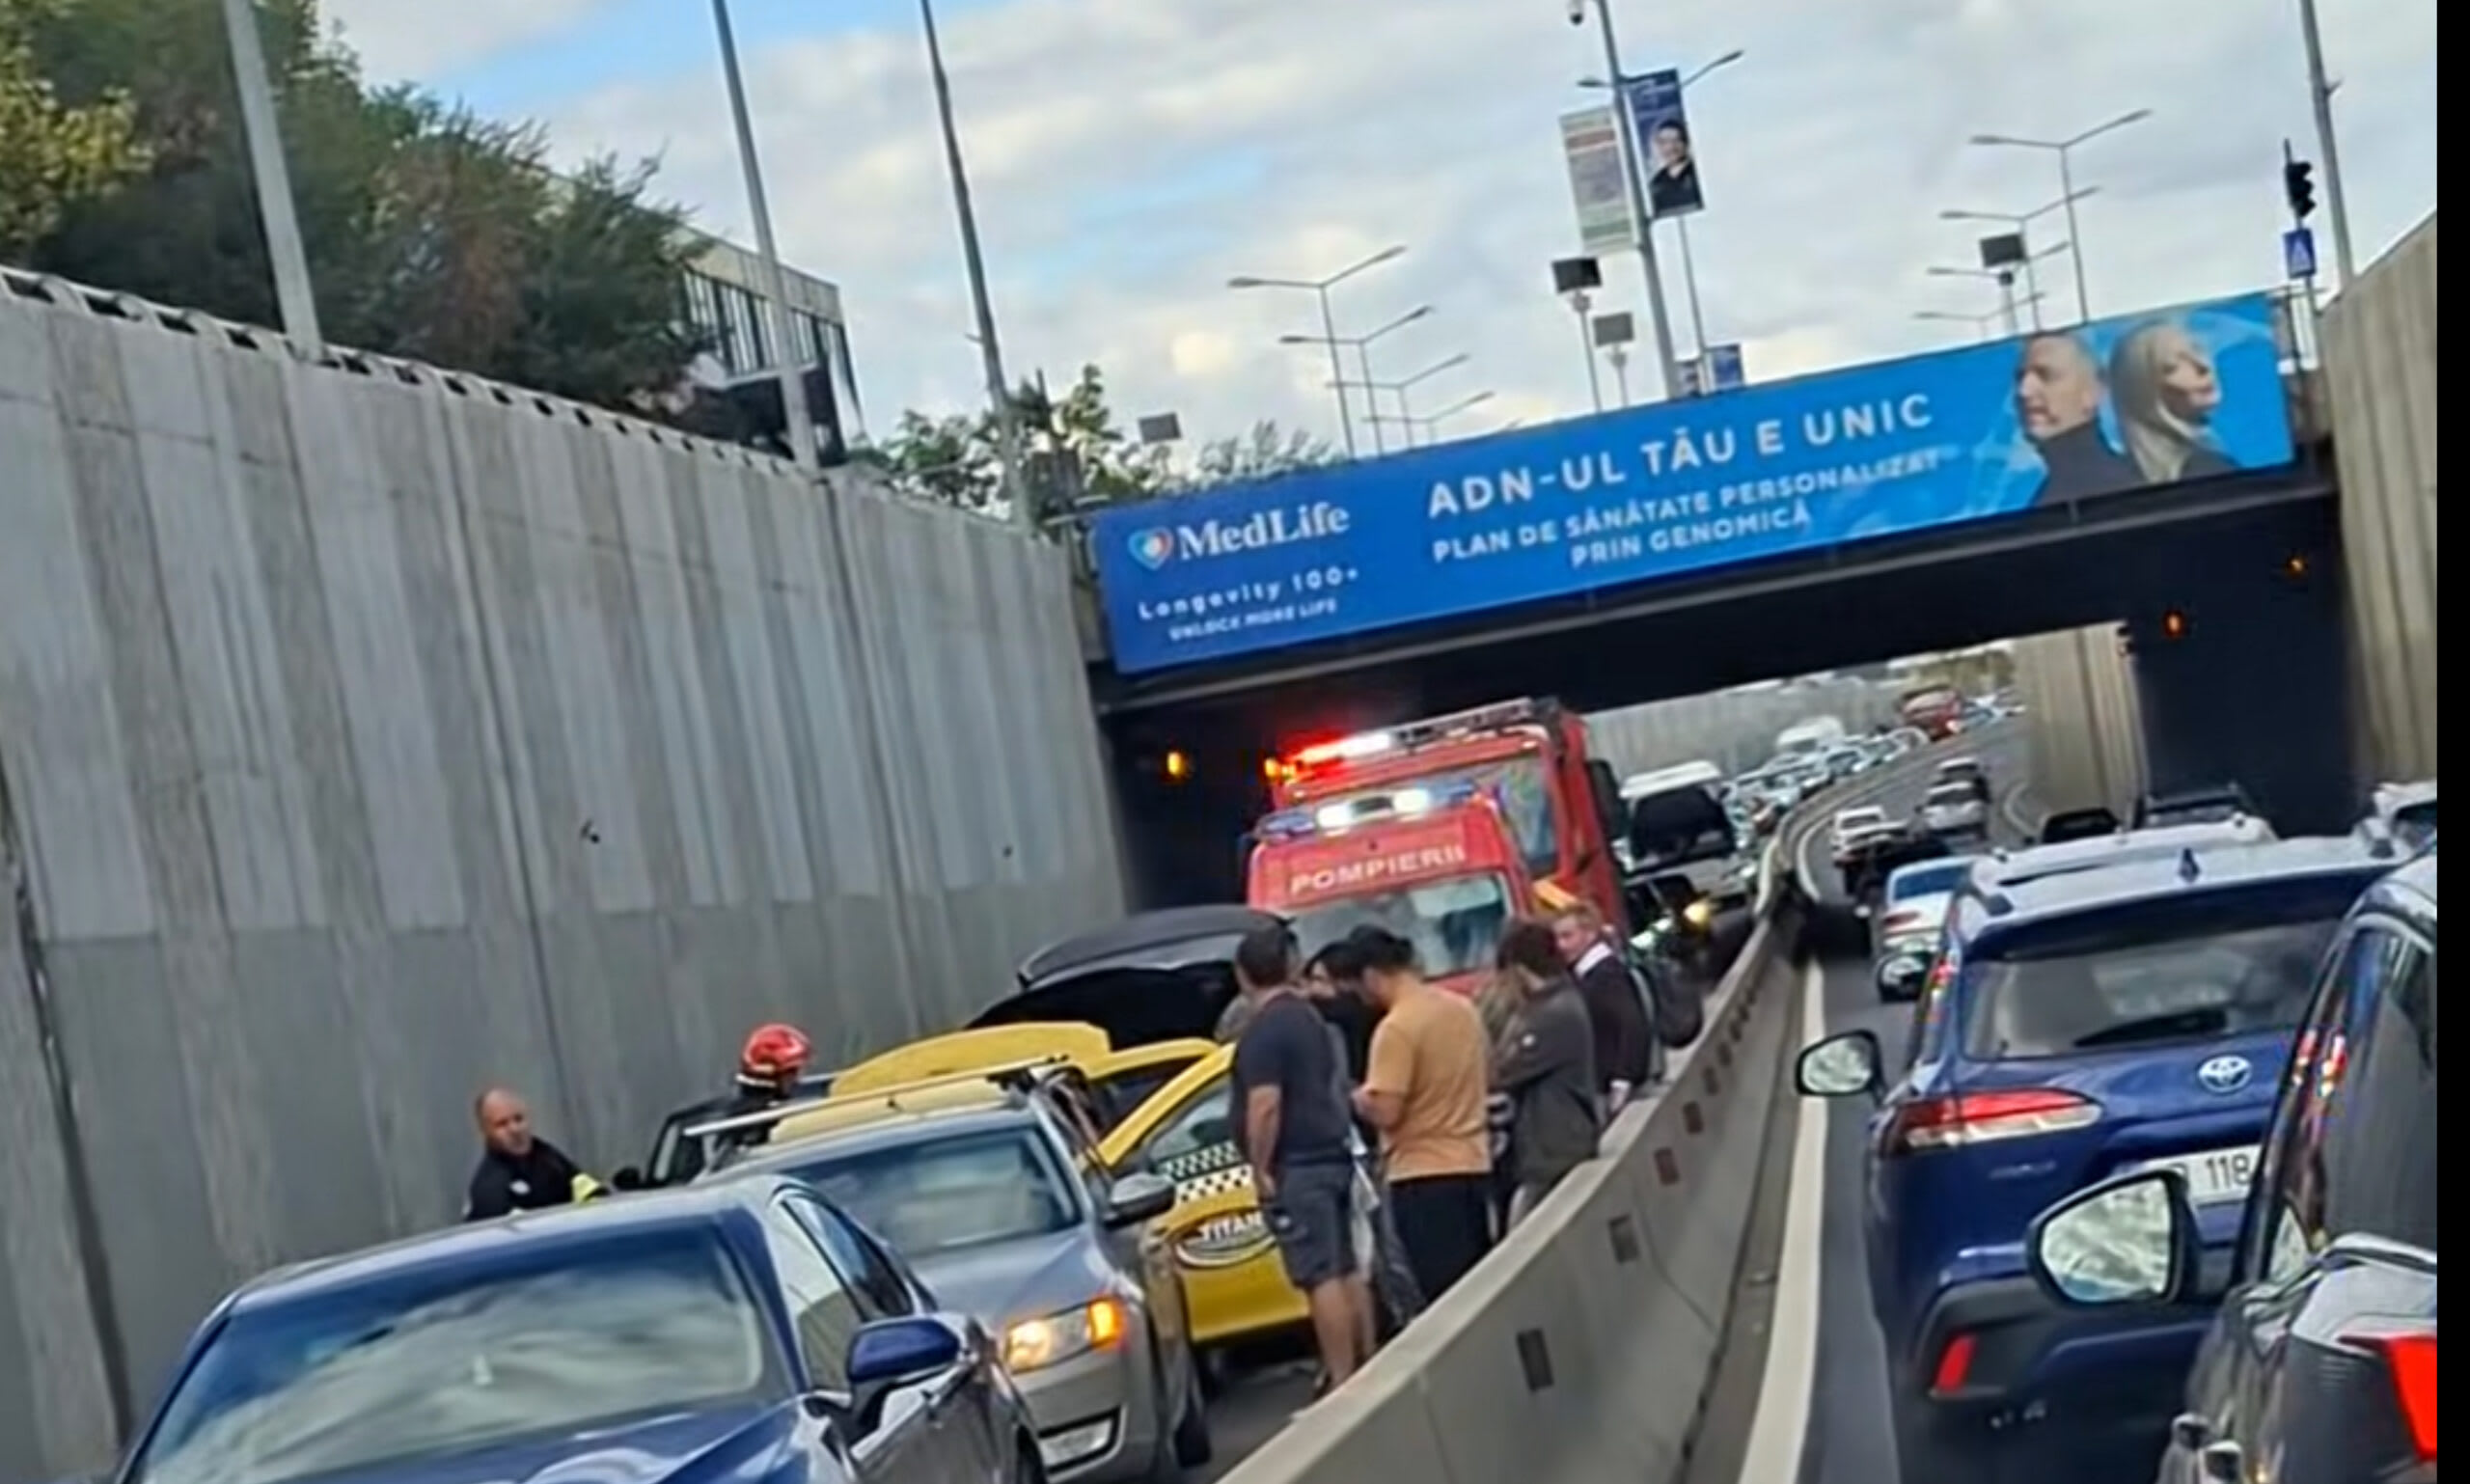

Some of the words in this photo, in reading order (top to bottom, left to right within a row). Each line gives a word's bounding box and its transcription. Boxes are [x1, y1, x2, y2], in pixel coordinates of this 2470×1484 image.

[1428, 451, 1628, 519] ADN-UL
[1755, 418, 1785, 456] E
[1802, 393, 1934, 447] UNIC
[1176, 500, 1351, 562] MedLife
[1431, 529, 1511, 564] PLAN
[1518, 519, 1559, 547] DE
[1570, 534, 1641, 569] PRIN
[1137, 581, 1281, 621] Longevity
[1291, 565, 1358, 592] 100+
[1289, 844, 1467, 896] POMPIERII
[2205, 1153, 2251, 1190] 118
